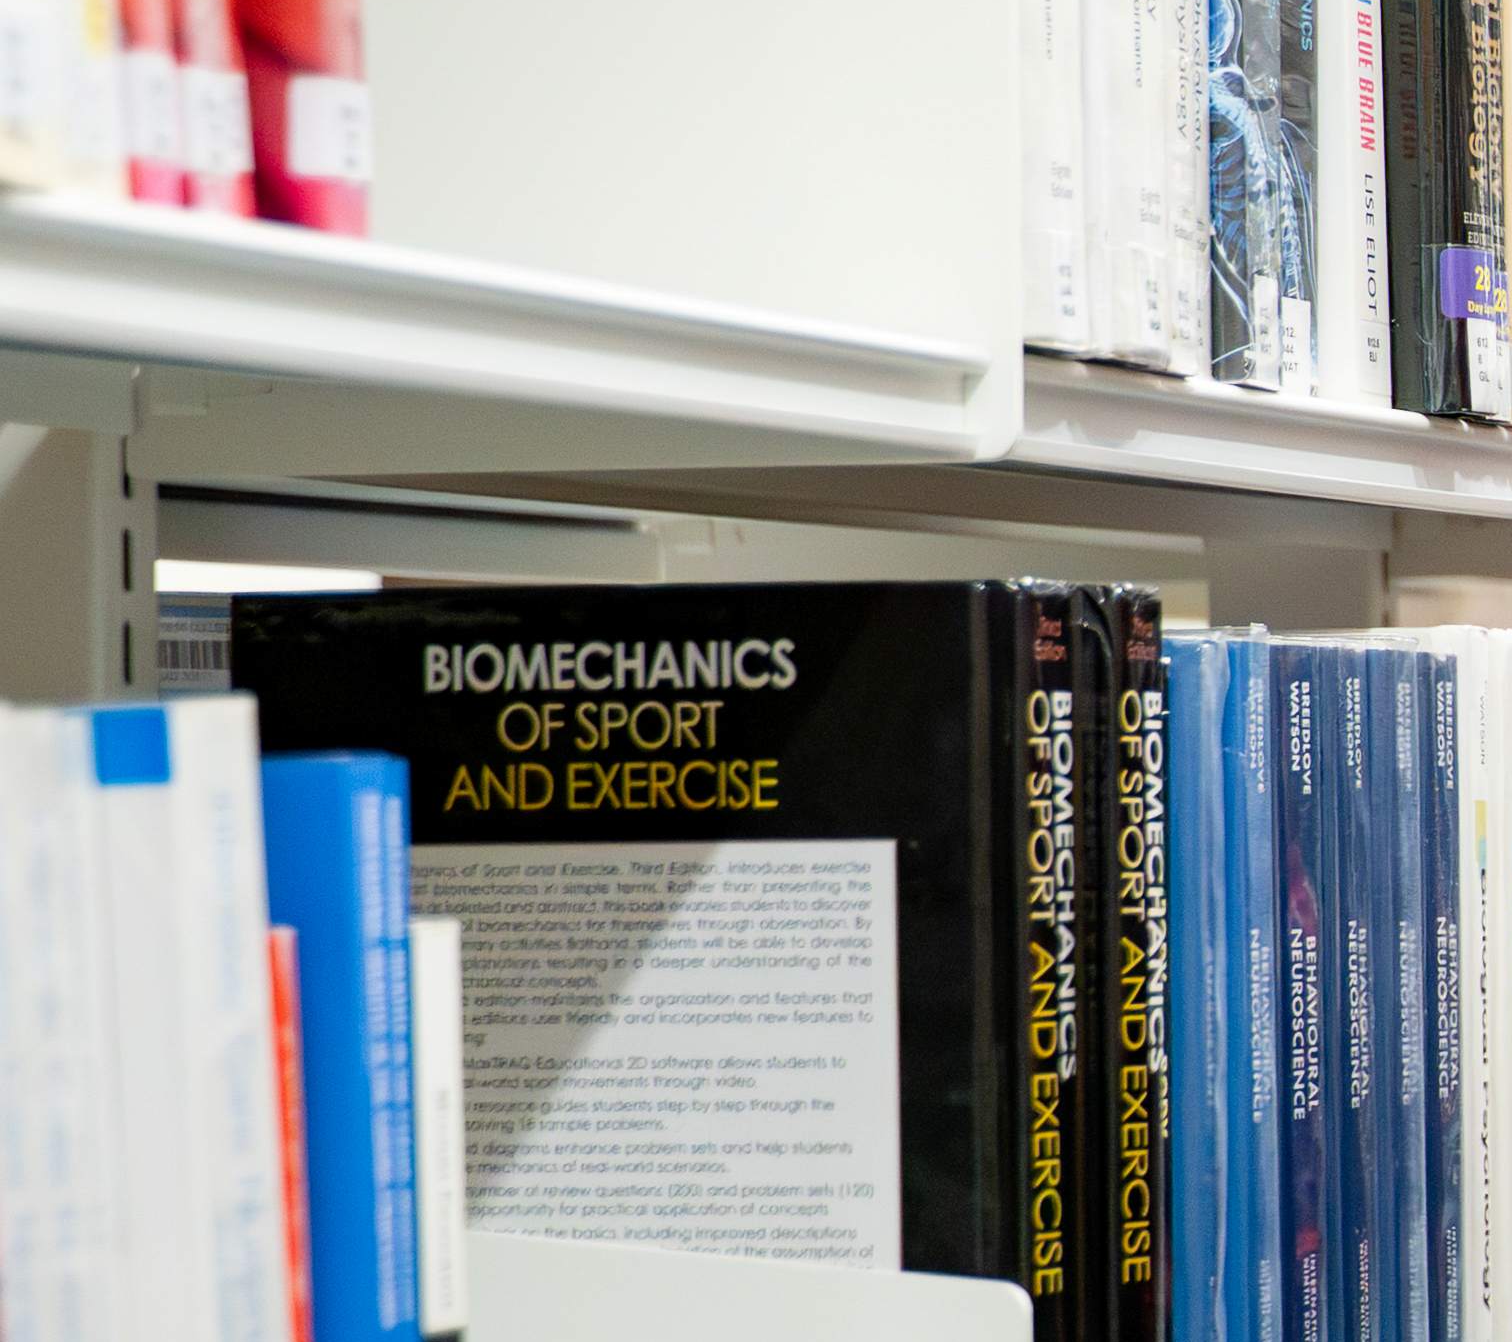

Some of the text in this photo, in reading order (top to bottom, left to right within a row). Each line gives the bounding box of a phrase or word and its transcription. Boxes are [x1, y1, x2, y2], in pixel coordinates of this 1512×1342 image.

[1356, 10, 1374, 69] BLUE
[1358, 77, 1377, 153] BRAIN
[1468, 20, 1489, 189] Biology
[1487, 20, 1503, 190] Biology
[1363, 173, 1379, 316] LISE ELIOT
[1475, 265, 1491, 292] 28
[1494, 288, 1508, 313] 28
[423, 638, 797, 695] BIOMECHANICS
[497, 701, 724, 752] OF SPORT
[1290, 680, 1302, 772] WATSON
[1301, 680, 1312, 796] BREEDLOVE
[1345, 676, 1356, 768] WATSON
[1353, 676, 1363, 790] BREEDLOVE
[1435, 680, 1447, 768] WATSON
[1444, 680, 1455, 790] BREEDLOVE
[443, 759, 780, 813] AND EXERCISE
[761, 880, 873, 896] presenting the
[810, 862, 872, 875] exercise
[1051, 689, 1078, 1082] BIOMECHANICS
[1142, 689, 1166, 1074] BIOMECHANICS
[697, 917, 754, 932] through
[810, 899, 872, 912] discover
[650, 956, 873, 971] deeper understanding the
[728, 936, 873, 951] be develop
[639, 991, 873, 1009] organization and features that
[1027, 689, 1063, 1297] OF SPORT AND EXERCISE
[1119, 689, 1152, 1284] OF SPORT AND EXERCISE
[1347, 919, 1361, 1110] NEUROSCIENCE
[1435, 915, 1451, 1100] NEUROSCIENCE
[623, 1010, 854, 1026] and incorporates new features
[1250, 927, 1263, 1124] NEUROSCIENCE
[1290, 927, 1307, 1122] NEUROSCIENCE
[1306, 934, 1320, 1112] BEHAVIOURAL
[650, 1055, 828, 1070] software students
[653, 1075, 711, 1091] through
[656, 1099, 836, 1115] step step through the
[721, 1142, 853, 1156] and students
[559, 1202, 829, 1218] for application concepts
[706, 1183, 738, 1197] and
[694, 1226, 767, 1242] improved
